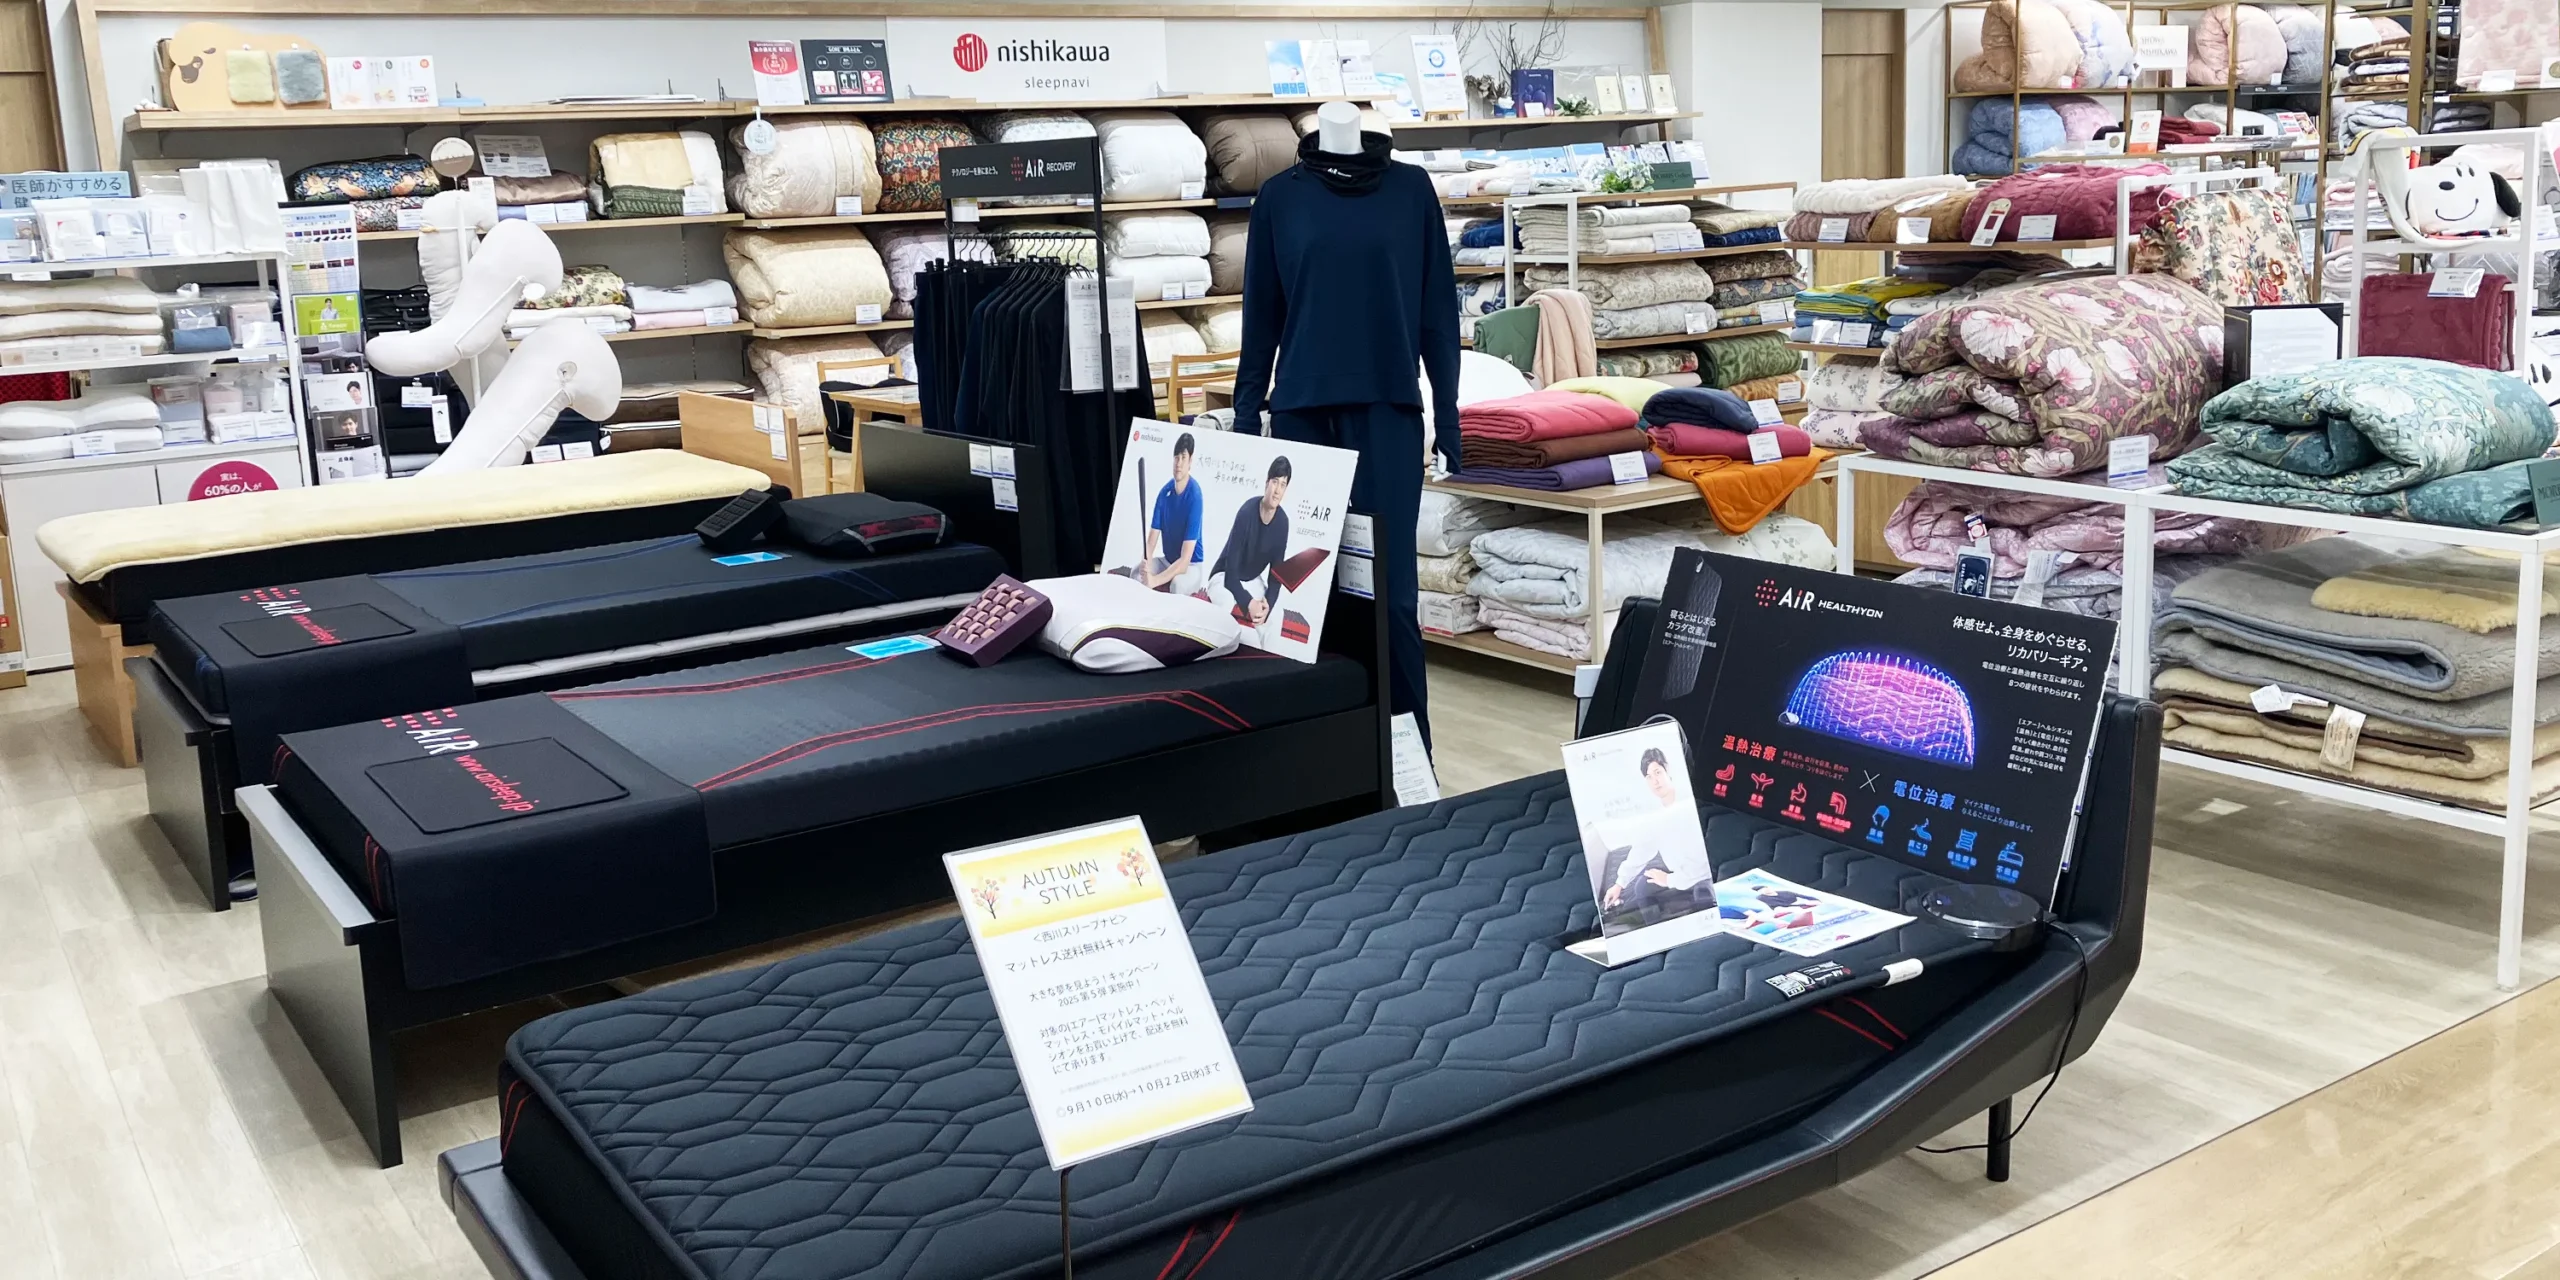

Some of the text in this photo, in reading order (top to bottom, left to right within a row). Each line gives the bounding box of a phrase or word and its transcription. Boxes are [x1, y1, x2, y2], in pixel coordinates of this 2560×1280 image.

[997, 39, 1110, 62] nishikawa
[1024, 76, 1090, 90] sleepnavi
[1046, 161, 1077, 172] RECOVERY
[11, 176, 122, 194] 医師がすすめる
[220, 472, 243, 482] 実は、
[204, 481, 262, 497] 60%の人が
[1670, 609, 1717, 627] 寝るとはじまる
[1818, 599, 1884, 619] HEALTHYON
[1667, 621, 1706, 637] カラダ改善。
[1952, 615, 2092, 653] 体感せよ。全身をめぐらせる、
[2008, 644, 2088, 672] リカバリーギア。
[1982, 661, 2085, 688] 電位治療と温熱治療を交互に繰り返し
[2008, 679, 2082, 701] 8つの症状をやわらげます。
[1722, 734, 1777, 762] 温熱治療
[1893, 779, 1956, 811] 電位治療
[1963, 798, 2001, 815] マイナス電位を
[1908, 839, 1928, 852] 肩こり
[1022, 858, 1100, 890] AUTUMN
[1038, 879, 1097, 905] STYLE
[1004, 926, 1167, 972] マットレス送料無料キャンペーン
[1029, 962, 1160, 1002] 大きな夢を見よう！キャンペーン
[1044, 1005, 1184, 1049] マットレス・モバイルマット・ヘル
[1049, 1015, 1189, 1062] シオンをお買い上げで、配送を無料
